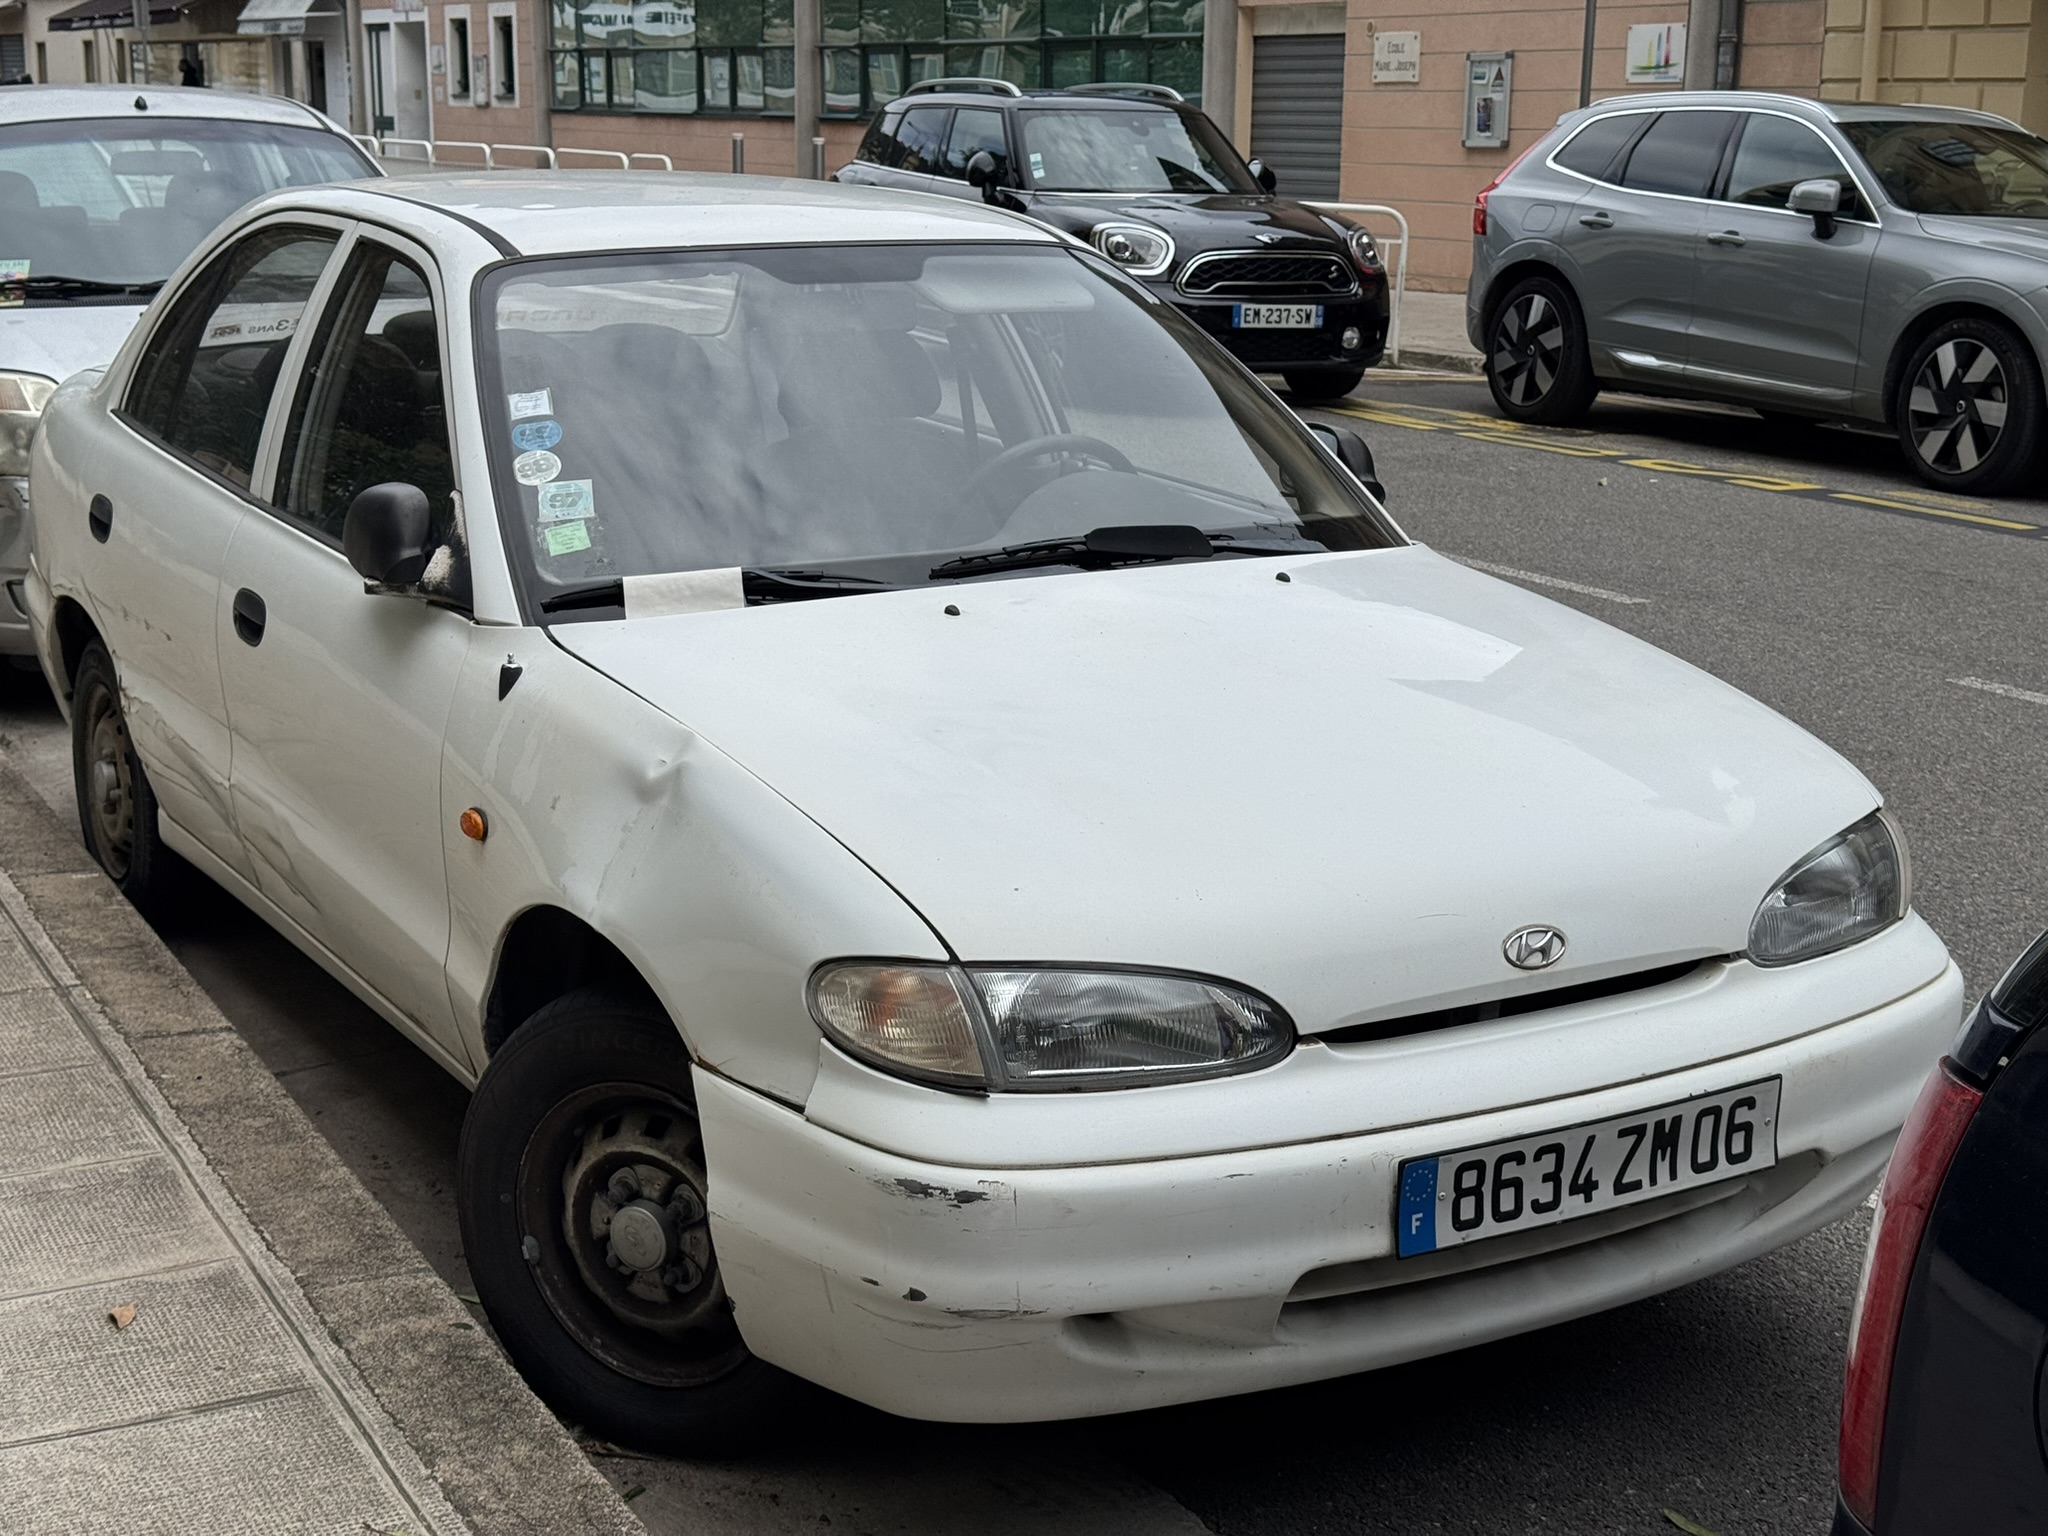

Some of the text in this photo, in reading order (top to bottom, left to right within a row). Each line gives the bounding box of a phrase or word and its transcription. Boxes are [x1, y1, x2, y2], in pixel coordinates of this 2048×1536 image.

[517, 457, 556, 480] 98
[548, 491, 584, 509] 97
[1451, 1096, 1757, 1232] 8634 ZM 06
[1411, 1212, 1424, 1235] F
